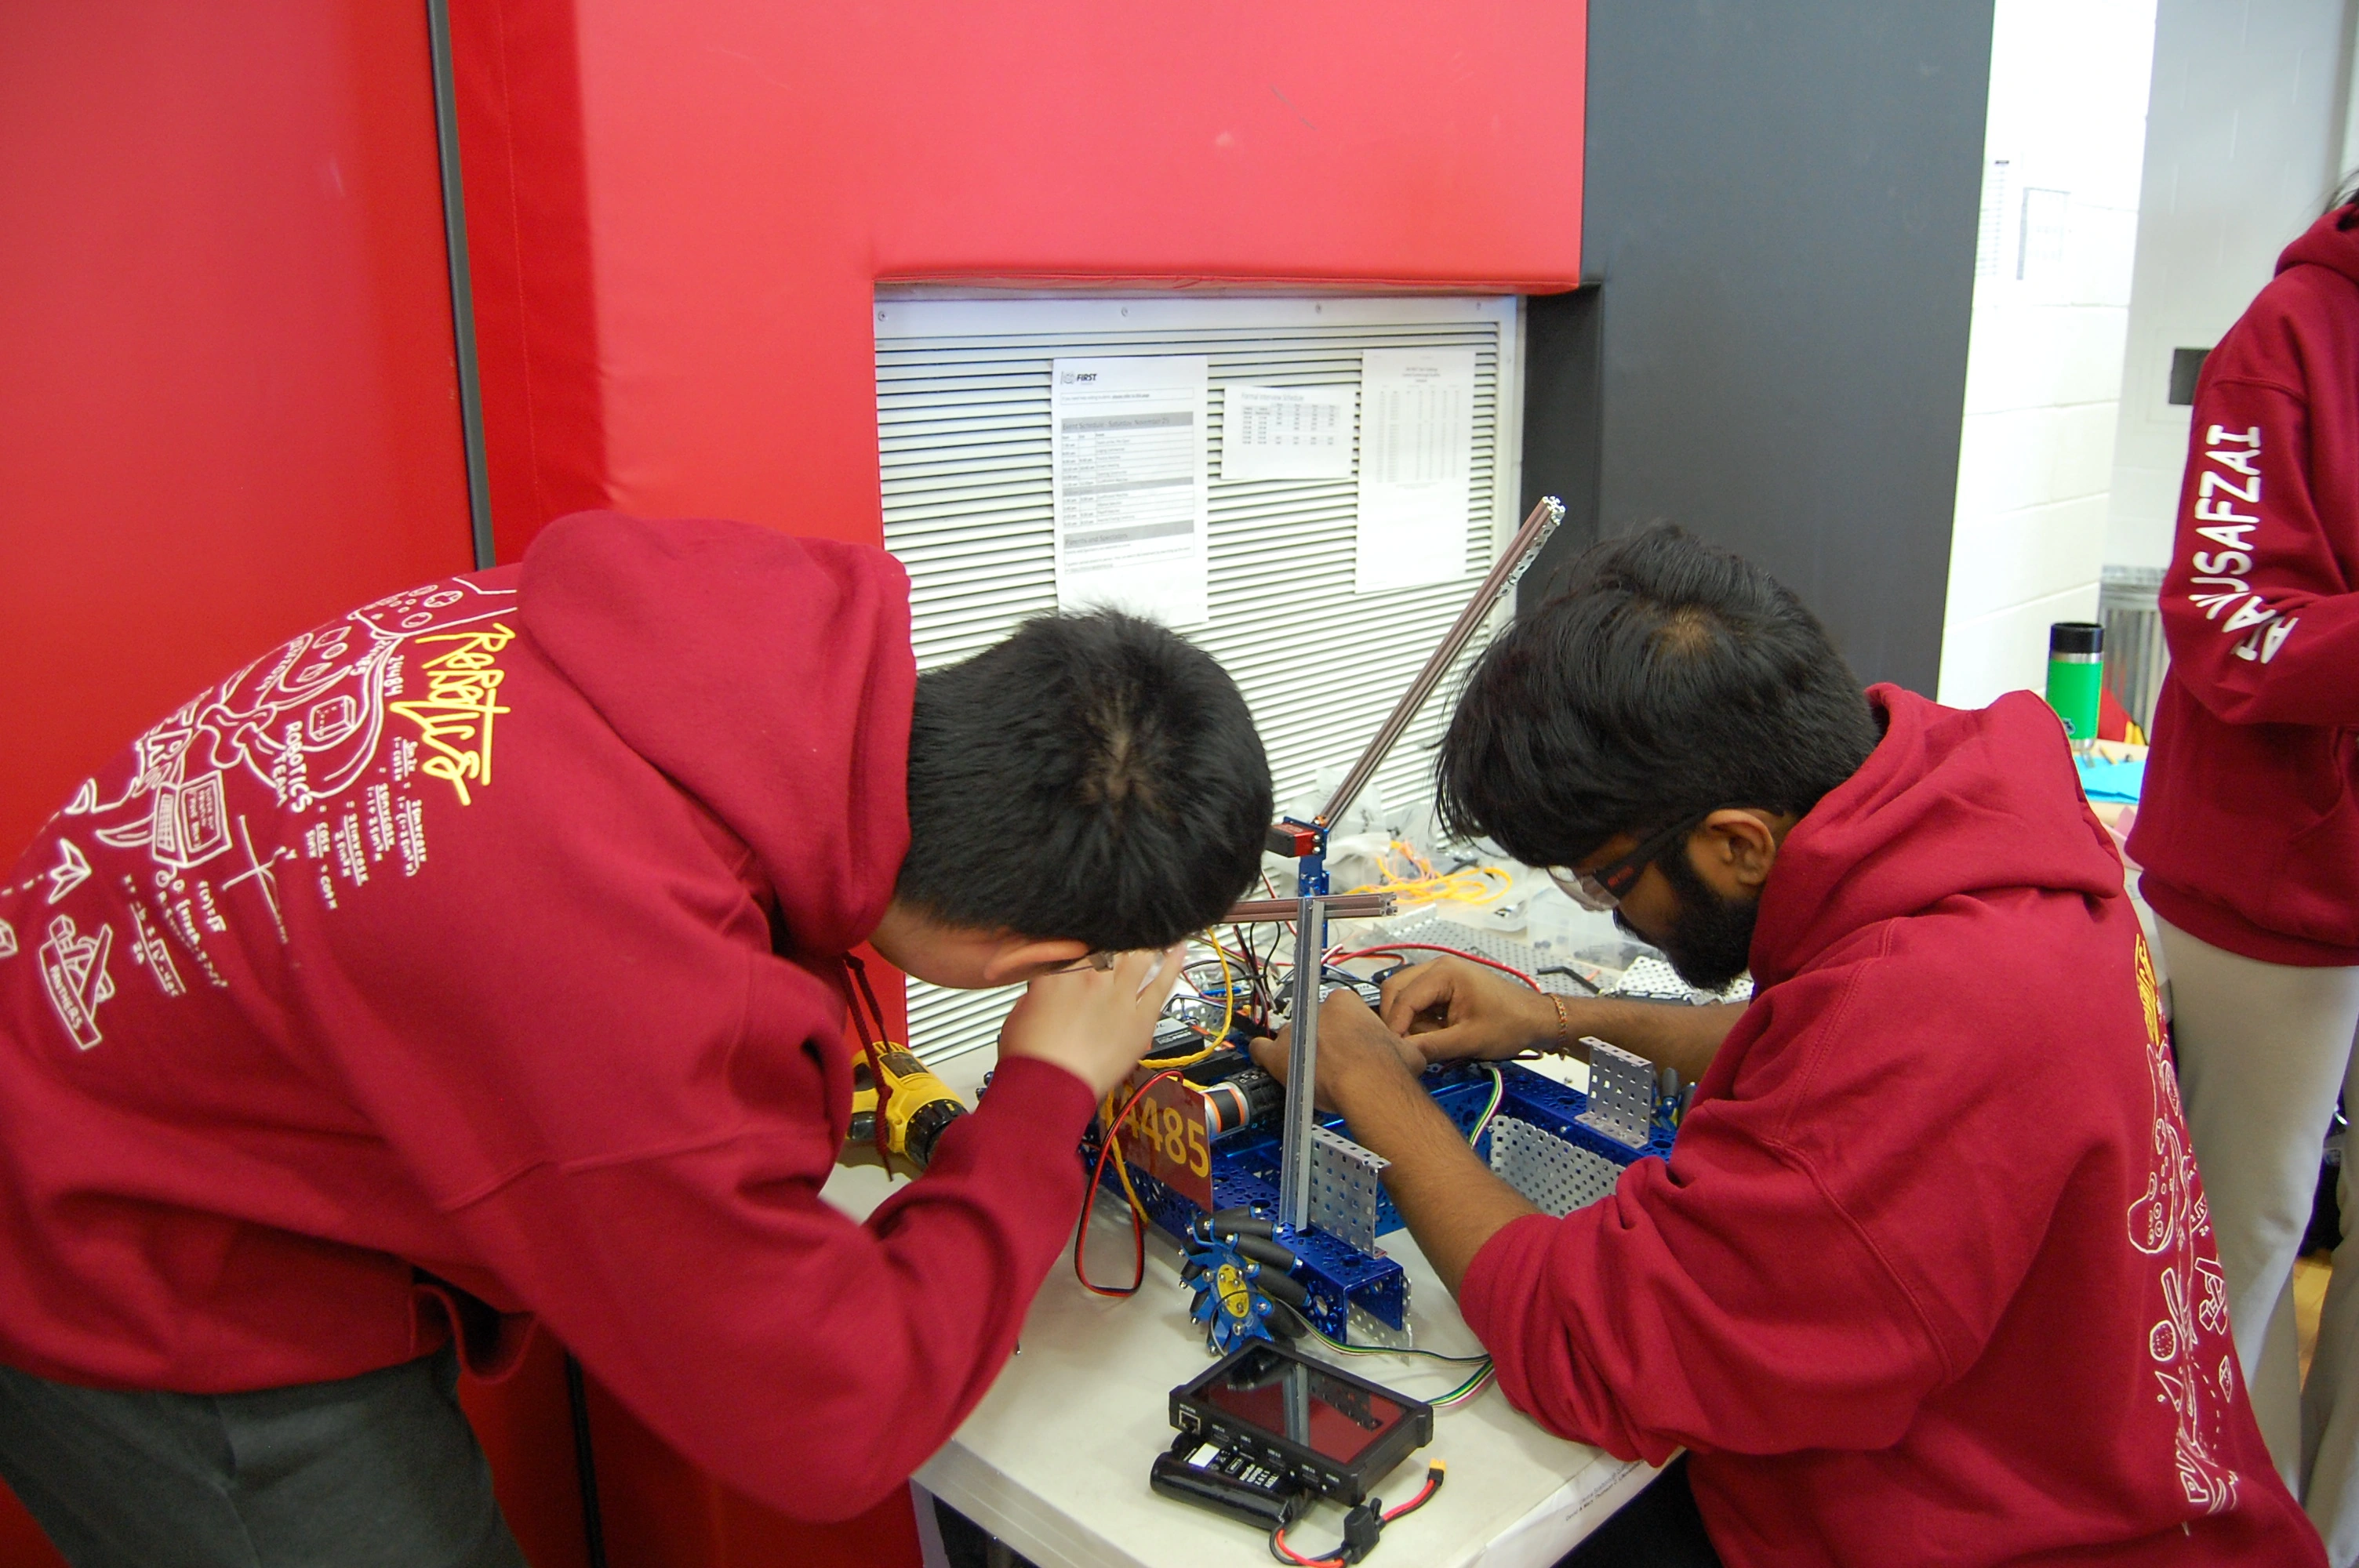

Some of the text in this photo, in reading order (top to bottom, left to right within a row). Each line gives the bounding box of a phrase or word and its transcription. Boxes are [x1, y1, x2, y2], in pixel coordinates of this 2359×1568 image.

[1077, 373, 1097, 382] FIRST
[2188, 424, 2261, 619] YUSAFZAI
[383, 655, 405, 697] 24484
[273, 751, 288, 808] TEAM
[285, 720, 313, 813] ROBOTICS
